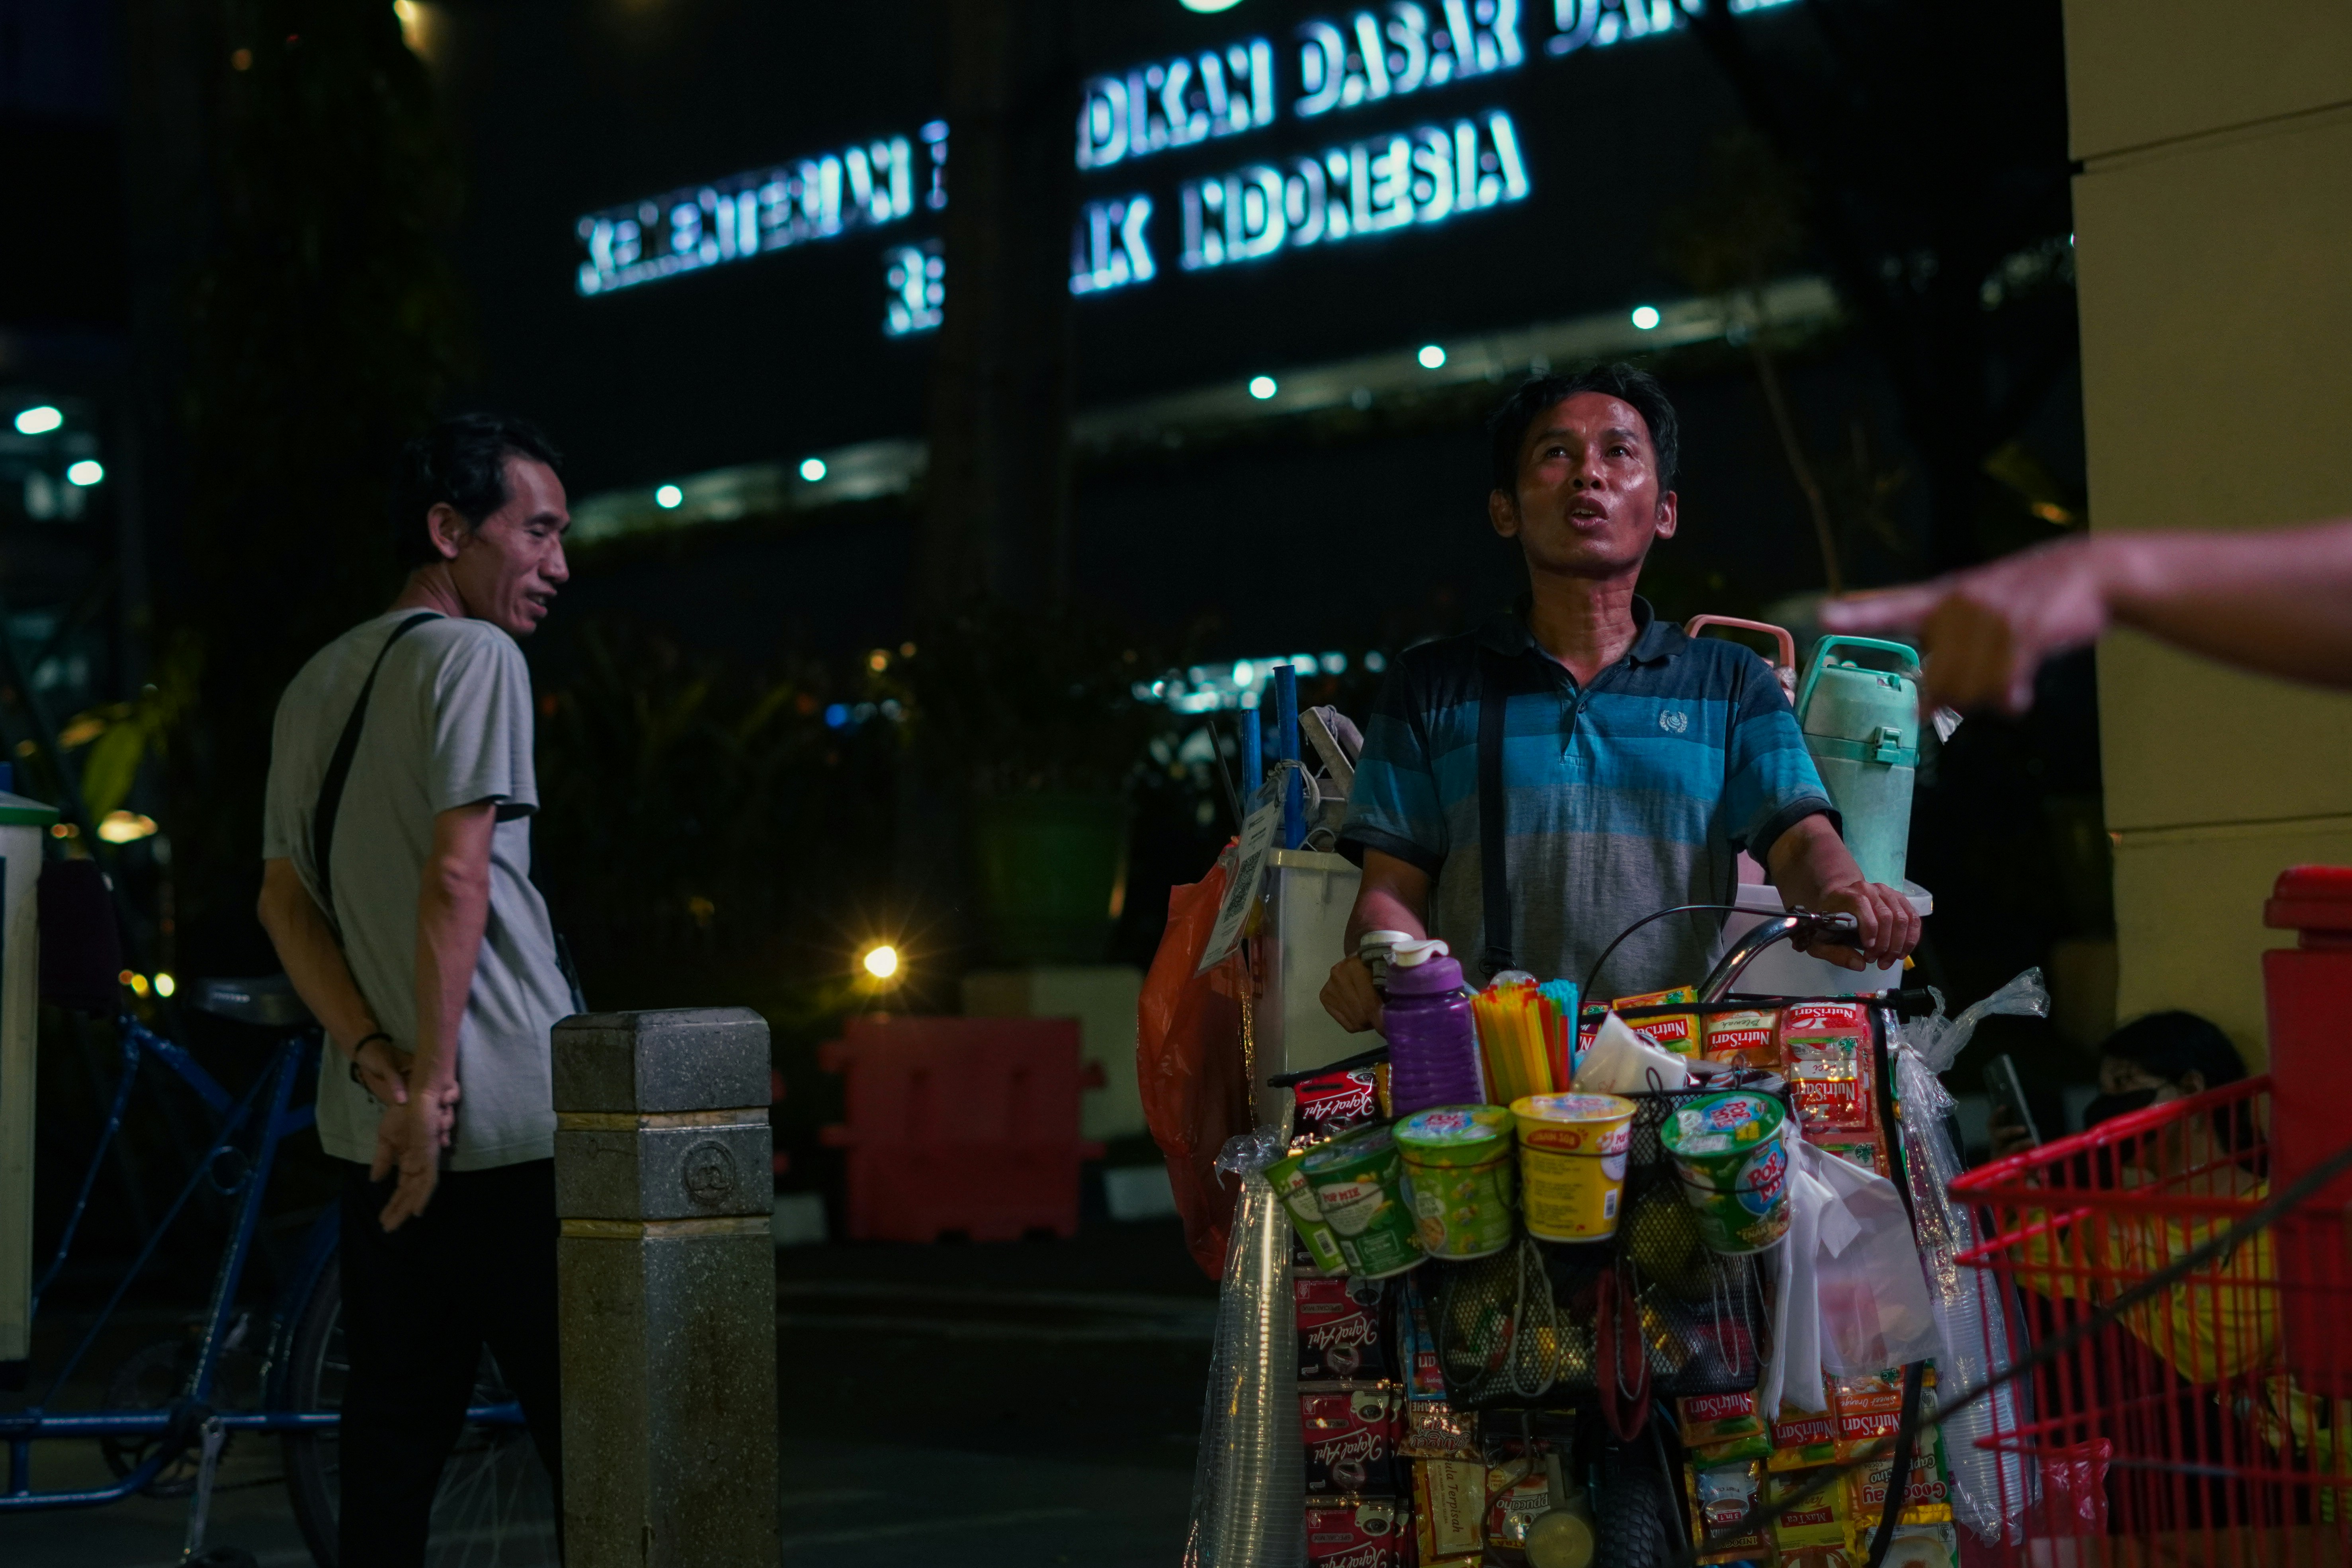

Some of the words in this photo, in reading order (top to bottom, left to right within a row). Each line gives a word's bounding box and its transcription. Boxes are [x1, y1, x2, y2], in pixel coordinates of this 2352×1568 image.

[1295, 0, 1524, 117] DASAR
[1181, 111, 1529, 271] INDONESIA
[1720, 1019, 1760, 1029] Blewah
[1795, 1007, 1853, 1019] NutriSari
[1711, 1031, 1770, 1049] NutriSari
[1795, 1081, 1855, 1101] NutriSari
[1303, 1101, 1333, 1121] Api
[1331, 1092, 1375, 1117] Kapal
[1748, 1152, 1777, 1188] POP
[1307, 1327, 1336, 1351] Api
[1335, 1316, 1378, 1347] Kapal
[1690, 1393, 1750, 1418] NutriSari
[1840, 1396, 1868, 1408] Orange
[1870, 1395, 1896, 1406] Sweet
[1775, 1419, 1834, 1443] NutriSari
[1842, 1414, 1901, 1436] NutriSari
[1313, 1442, 1341, 1466] Api
[1340, 1432, 1382, 1463] Kapal
[1446, 1484, 1465, 1533] Terpisah
[1496, 1493, 1549, 1513] ppuccino
[1786, 1512, 1827, 1525] MaxTea
